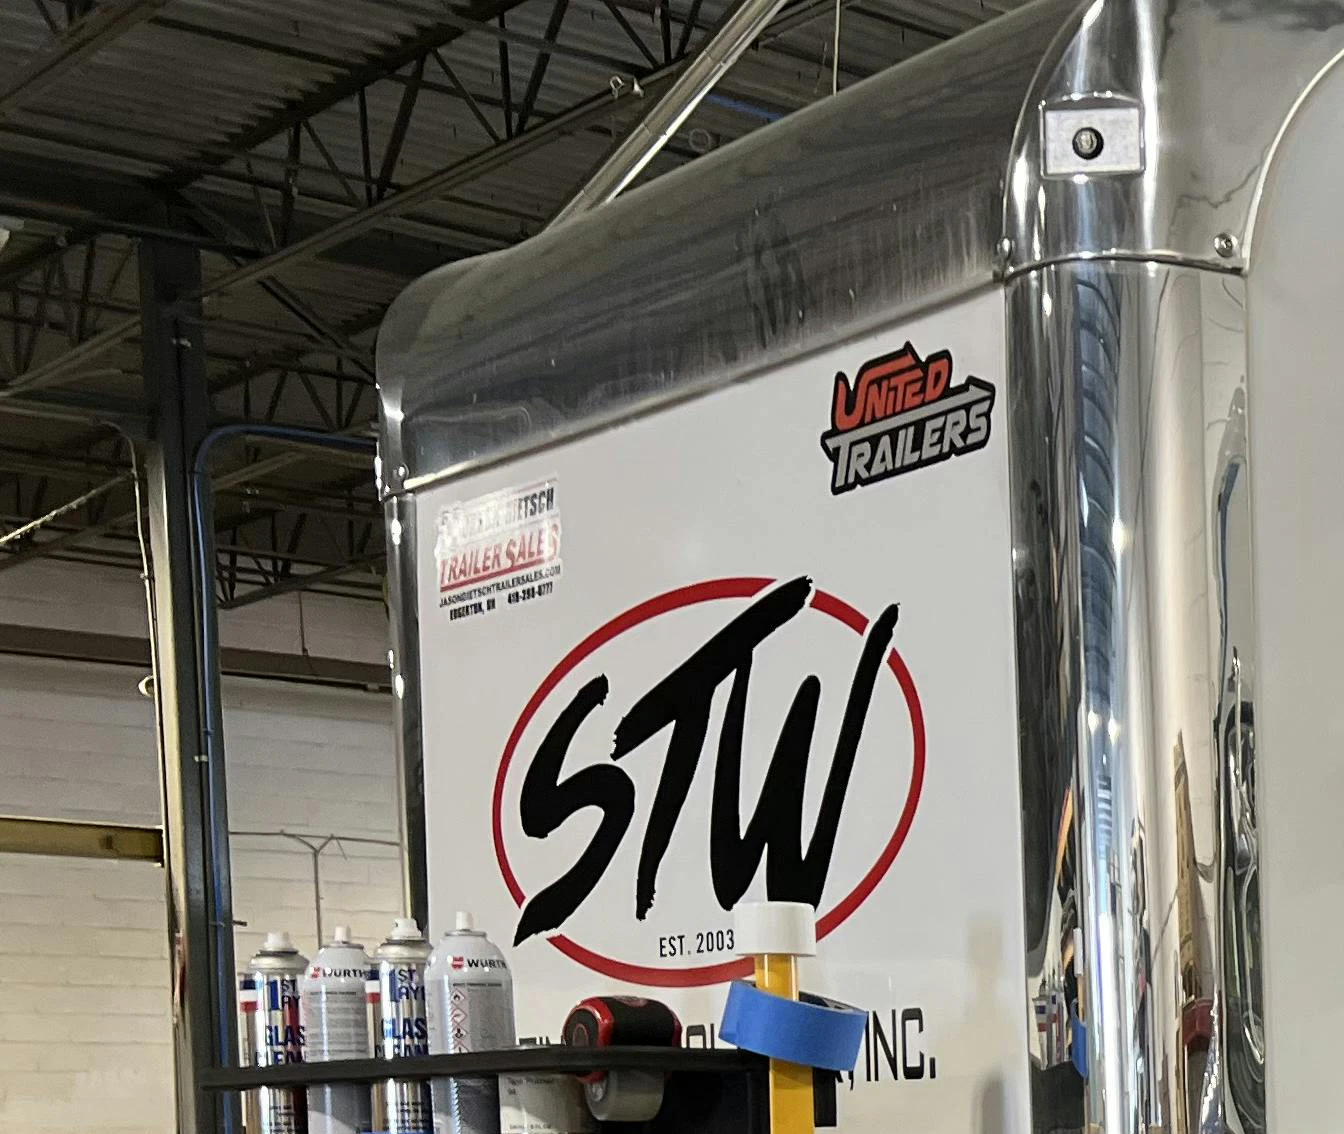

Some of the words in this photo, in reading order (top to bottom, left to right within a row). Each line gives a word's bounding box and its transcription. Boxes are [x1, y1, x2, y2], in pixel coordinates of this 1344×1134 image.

[825, 386, 992, 488] TRAILERS
[440, 543, 501, 585] TRAILER
[513, 574, 900, 948] STW
[659, 935, 692, 958] EST.
[696, 929, 736, 955] 2003
[864, 1007, 937, 1082] INC.
